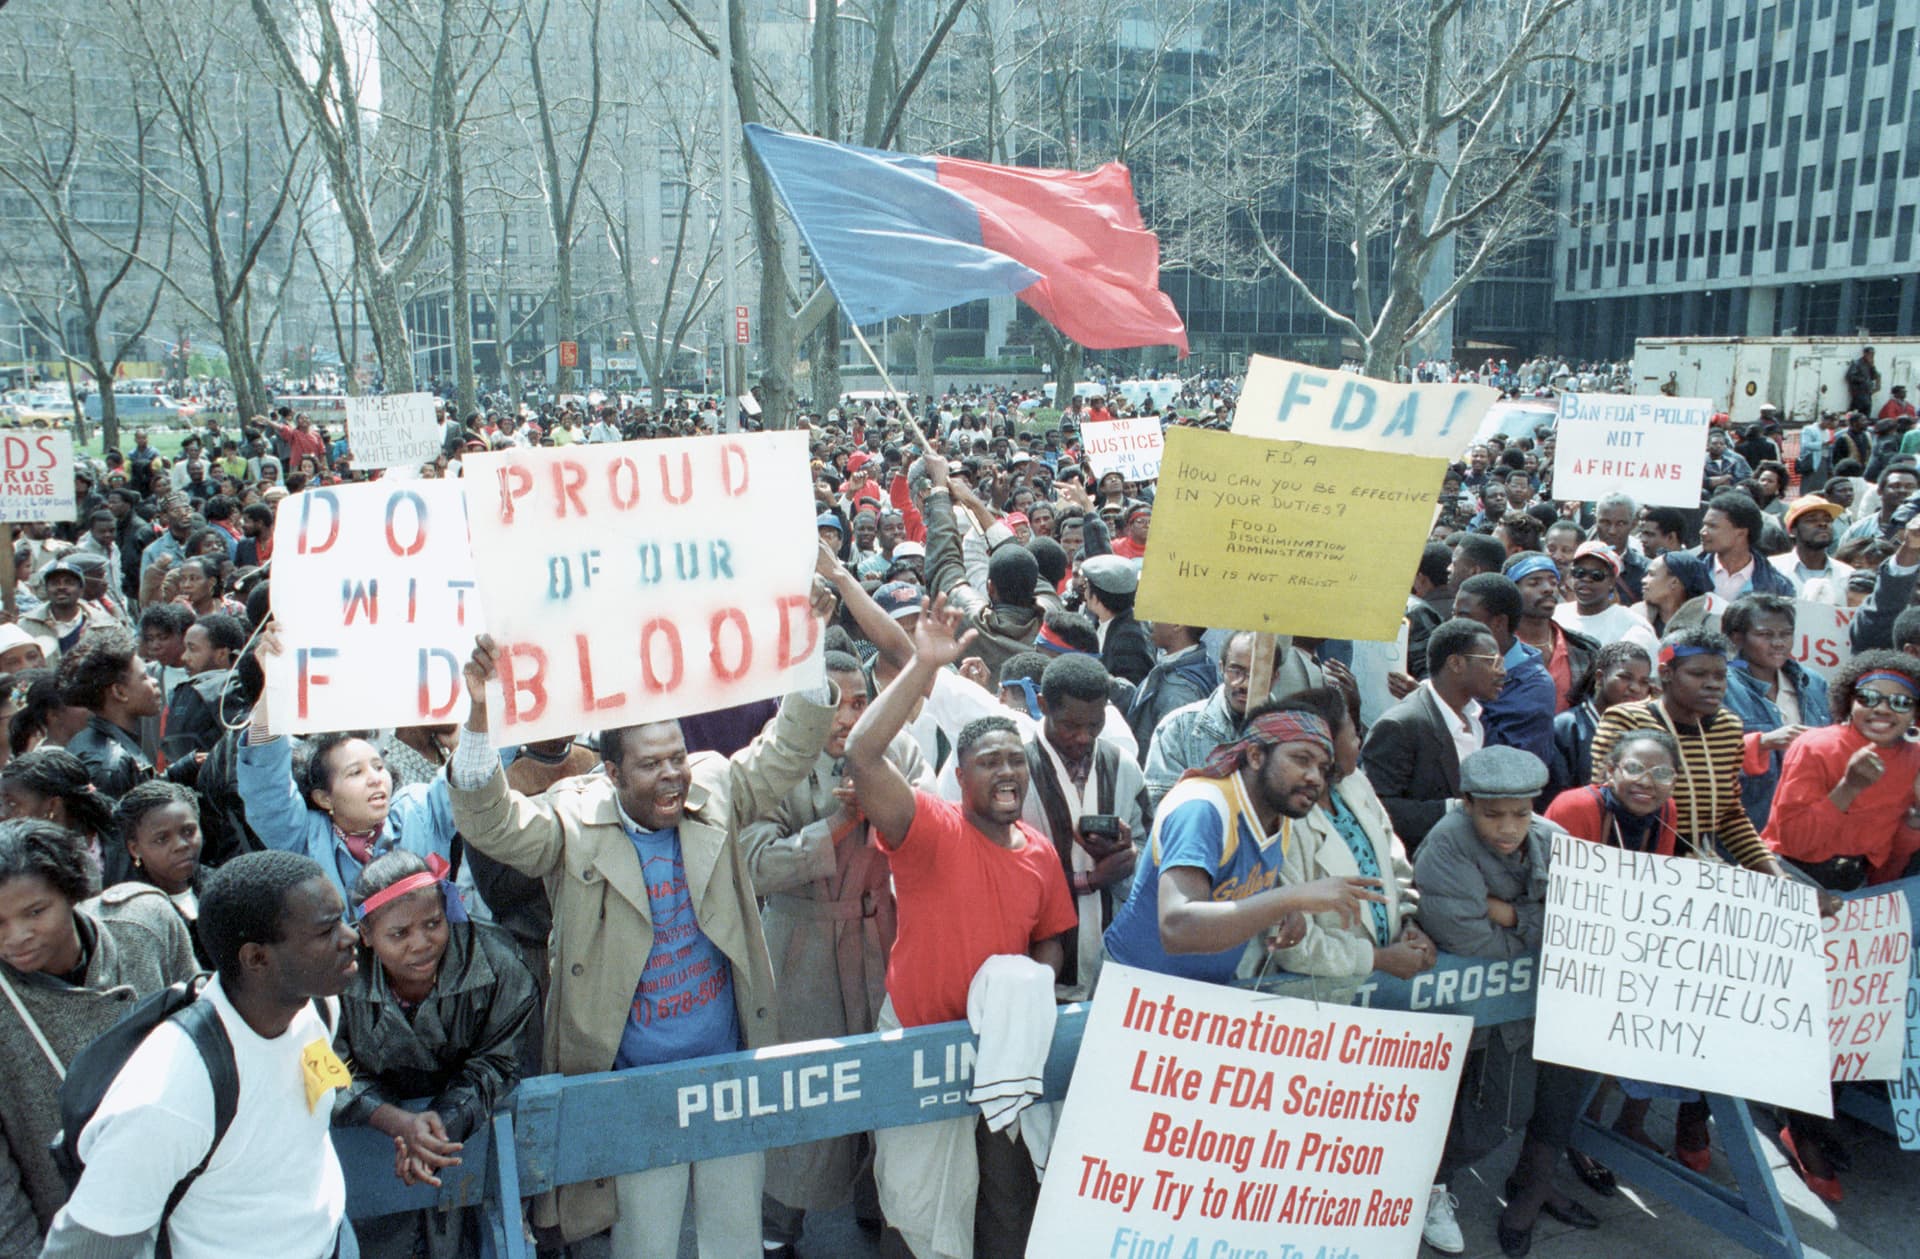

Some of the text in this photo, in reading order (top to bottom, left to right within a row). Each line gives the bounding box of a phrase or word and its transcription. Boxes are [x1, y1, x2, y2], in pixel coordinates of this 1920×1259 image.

[378, 408, 425, 427] HAITI
[1277, 371, 1470, 437] FDA!
[1561, 393, 1599, 421] BAN
[1654, 407, 1710, 426] POLICY
[351, 427, 413, 446] MADE IN
[1087, 433, 1160, 454] JUSTICE
[1112, 421, 1130, 432] NO
[1607, 430, 1645, 447] NOT
[355, 440, 438, 463] WHITE HOUSE
[1118, 453, 1136, 463] NO
[1573, 458, 1682, 480] AFRICANS
[8, 484, 54, 496] MADE
[497, 443, 749, 524] PROUD
[1178, 461, 1430, 502] HOW CAN YOU BE EFFECTIVE
[1175, 487, 1346, 517] IN YOUR DUTIES?
[297, 489, 473, 559] DO
[1228, 531, 1346, 550] DISCRIMINATION
[1231, 518, 1277, 533] FOOD
[547, 539, 734, 600] OF OUR
[1226, 543, 1345, 560] ADMINISTRATION
[1222, 570, 1238, 580] IS
[1248, 572, 1278, 583] NOT
[497, 595, 819, 725] BLOOD
[1552, 838, 1815, 916] AIDS HAS BEEN MADE
[1549, 873, 1568, 906] IN
[1702, 902, 1752, 938] AND
[1841, 892, 1901, 931] BEEN
[1545, 913, 1793, 989] IBUTED SPECIALLY IN
[1865, 931, 1909, 967] AND
[1410, 957, 1533, 1010] CROSS
[1541, 953, 1605, 998] HAITI
[1617, 970, 1658, 1007] BY
[1123, 986, 1452, 1071] International Criminals
[1608, 1012, 1706, 1059] ARMY.
[1850, 1010, 1891, 1045] BY
[678, 1059, 861, 1128] POLICE
[1130, 1050, 1419, 1123] Like FDA Scientists
[1143, 1111, 1384, 1175] Belong In Prison
[1078, 1155, 1414, 1228] They Try to Kill African Race
